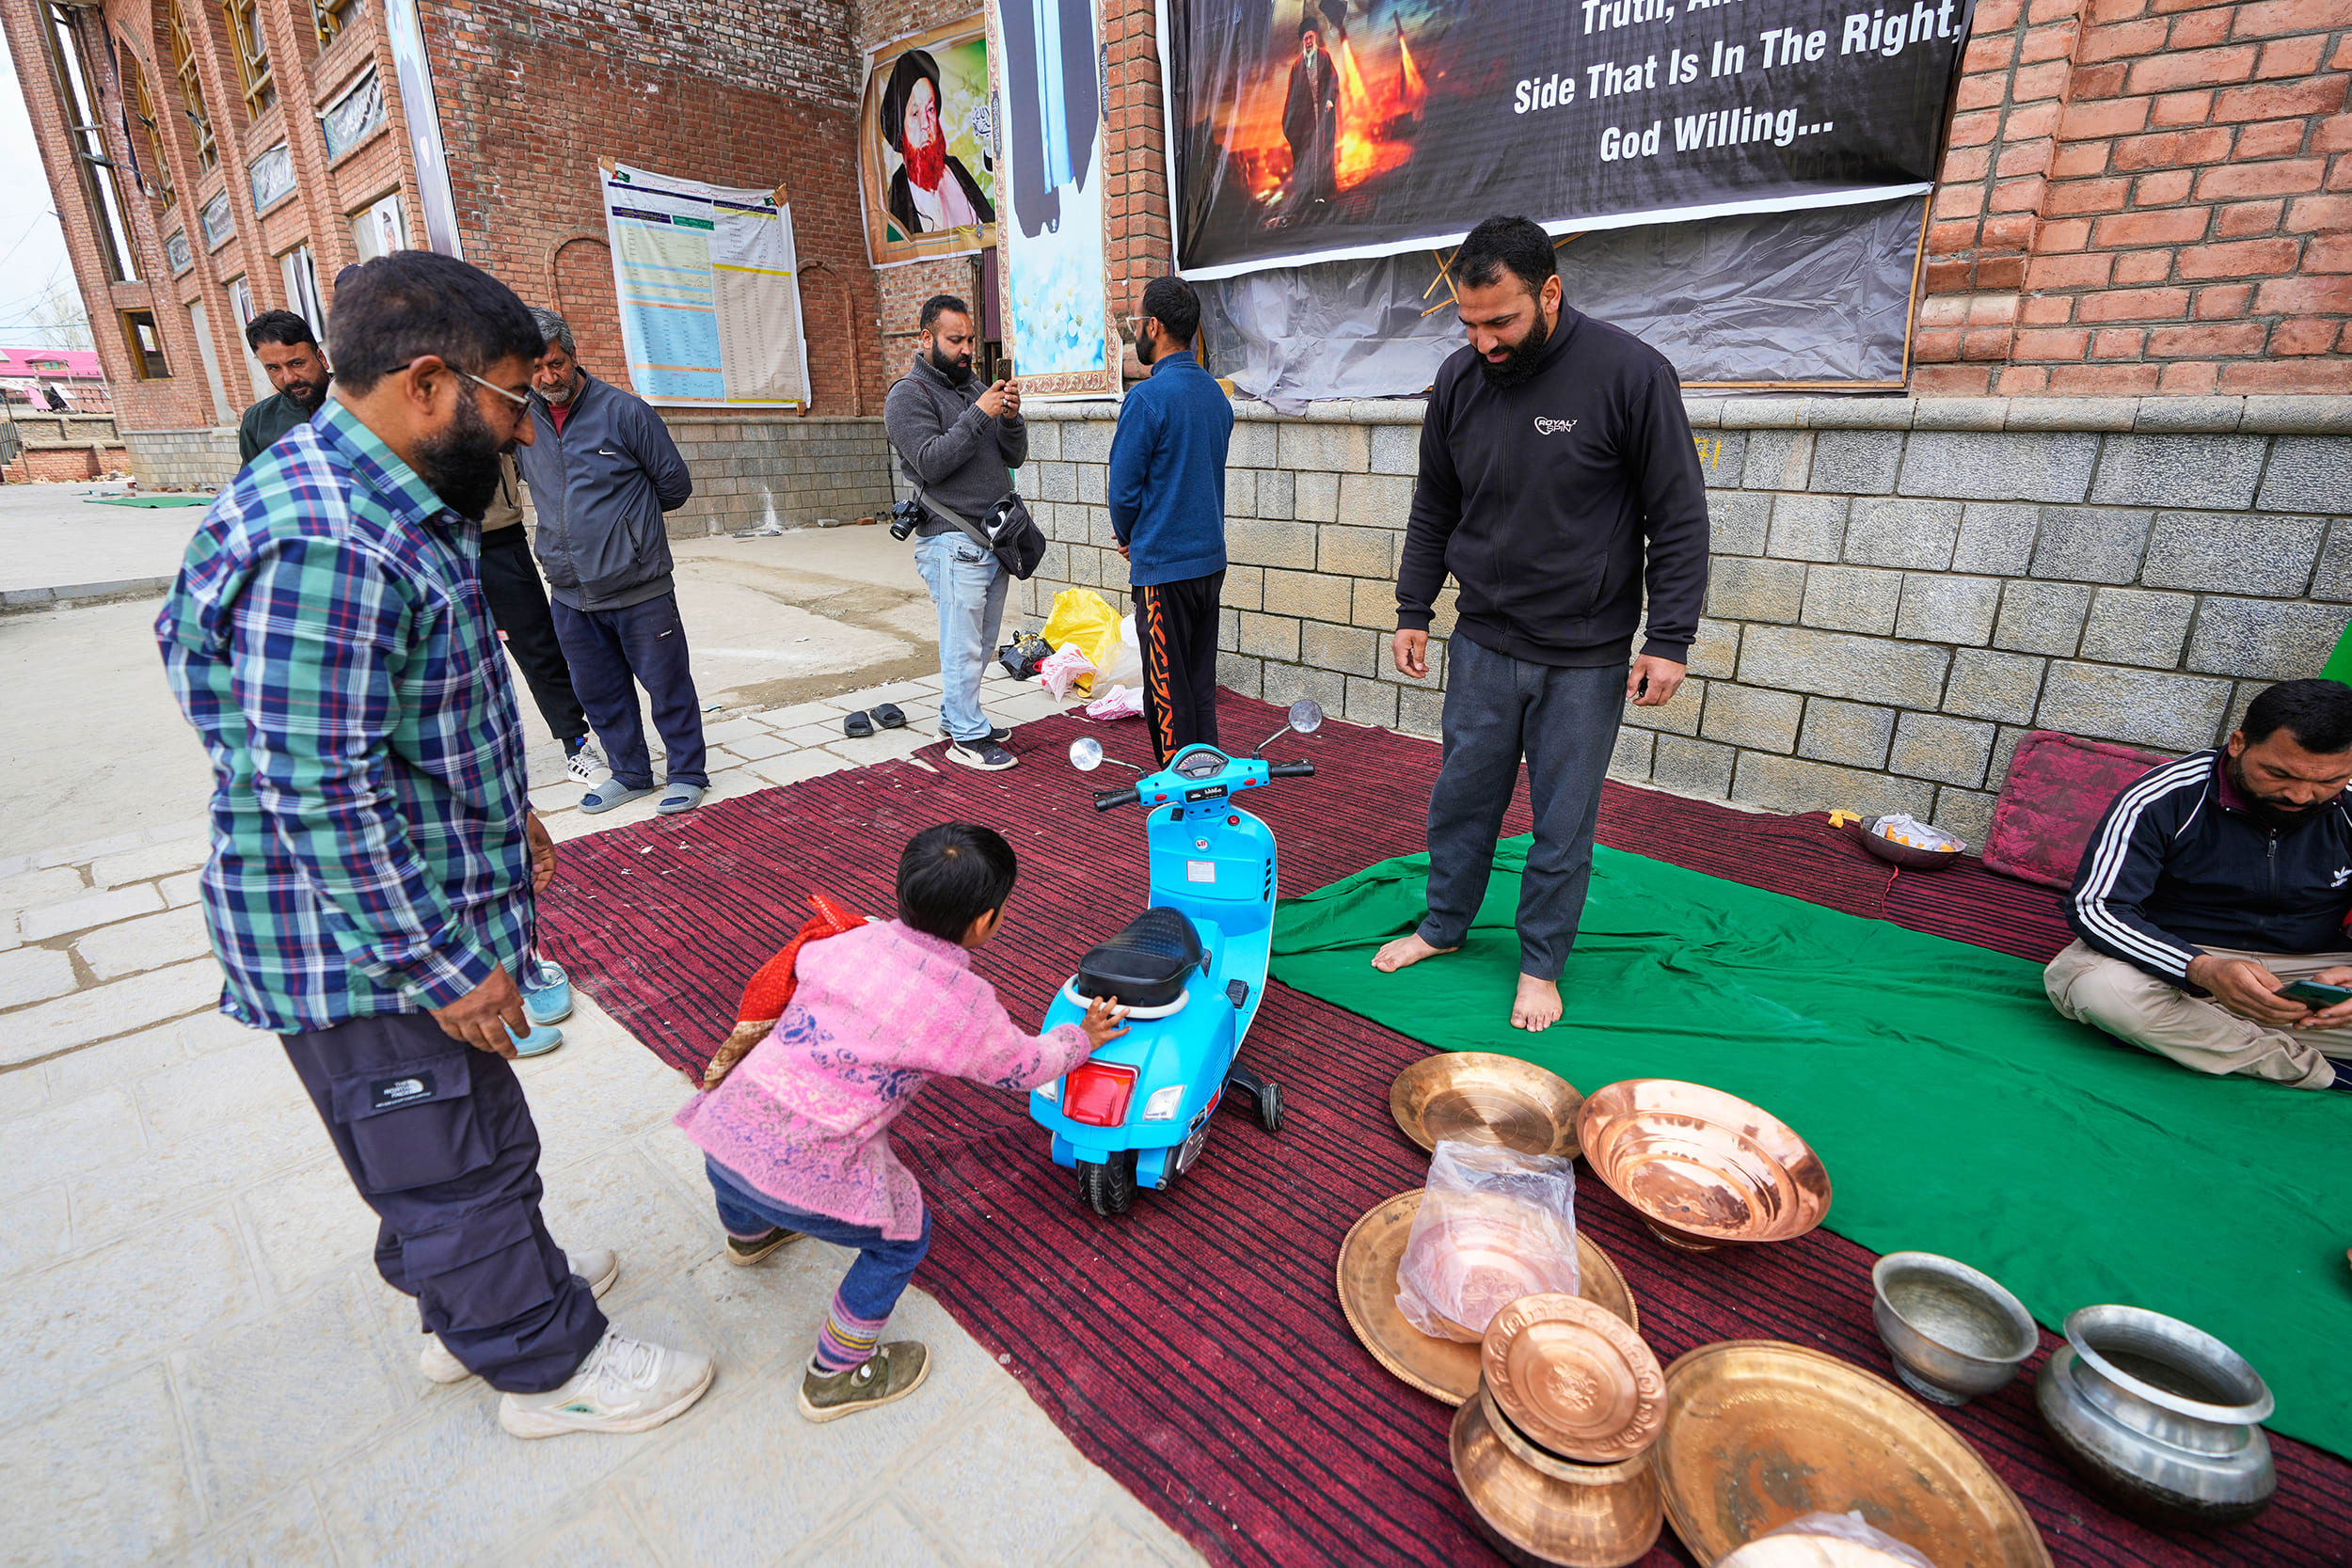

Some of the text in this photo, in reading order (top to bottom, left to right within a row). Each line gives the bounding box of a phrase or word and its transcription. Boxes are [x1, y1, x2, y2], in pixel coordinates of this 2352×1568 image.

[1581, 0, 1675, 35] Truth,
[1514, 0, 1962, 115] Side That Is In The Right,
[1600, 106, 1834, 162] God Willing...
[1538, 419, 1578, 427] ROYAL
